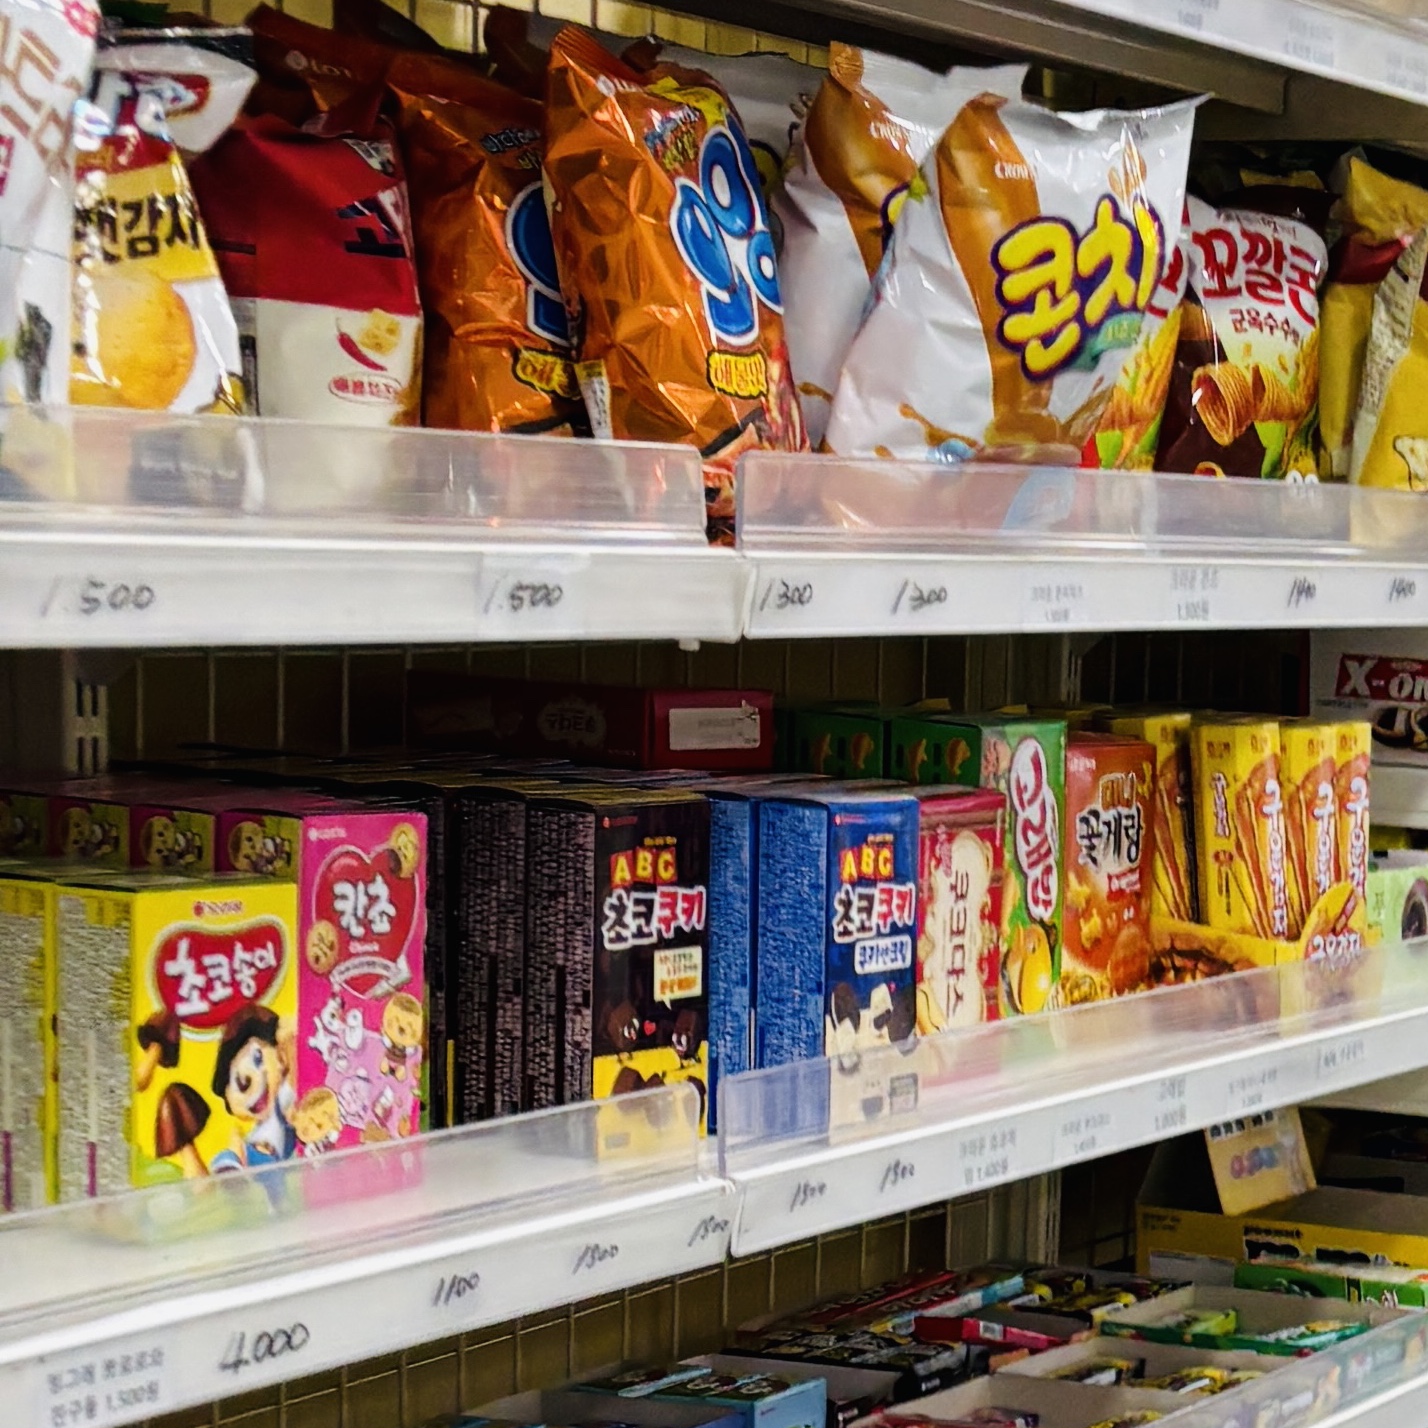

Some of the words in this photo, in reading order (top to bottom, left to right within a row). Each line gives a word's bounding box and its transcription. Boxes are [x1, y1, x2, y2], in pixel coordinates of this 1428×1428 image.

[1192, 226, 1318, 327] 꼬깔콘
[1012, 739, 1058, 914] 고래밥
[1077, 803, 1143, 870] 꽃게랑
[1315, 780, 1337, 896] 구운감
[611, 847, 677, 888] ABC
[840, 845, 893, 881] ABC
[602, 887, 706, 950] 초코쿠키
[832, 883, 916, 944] 초코쿠키
[164, 936, 276, 1017] 초코송이
